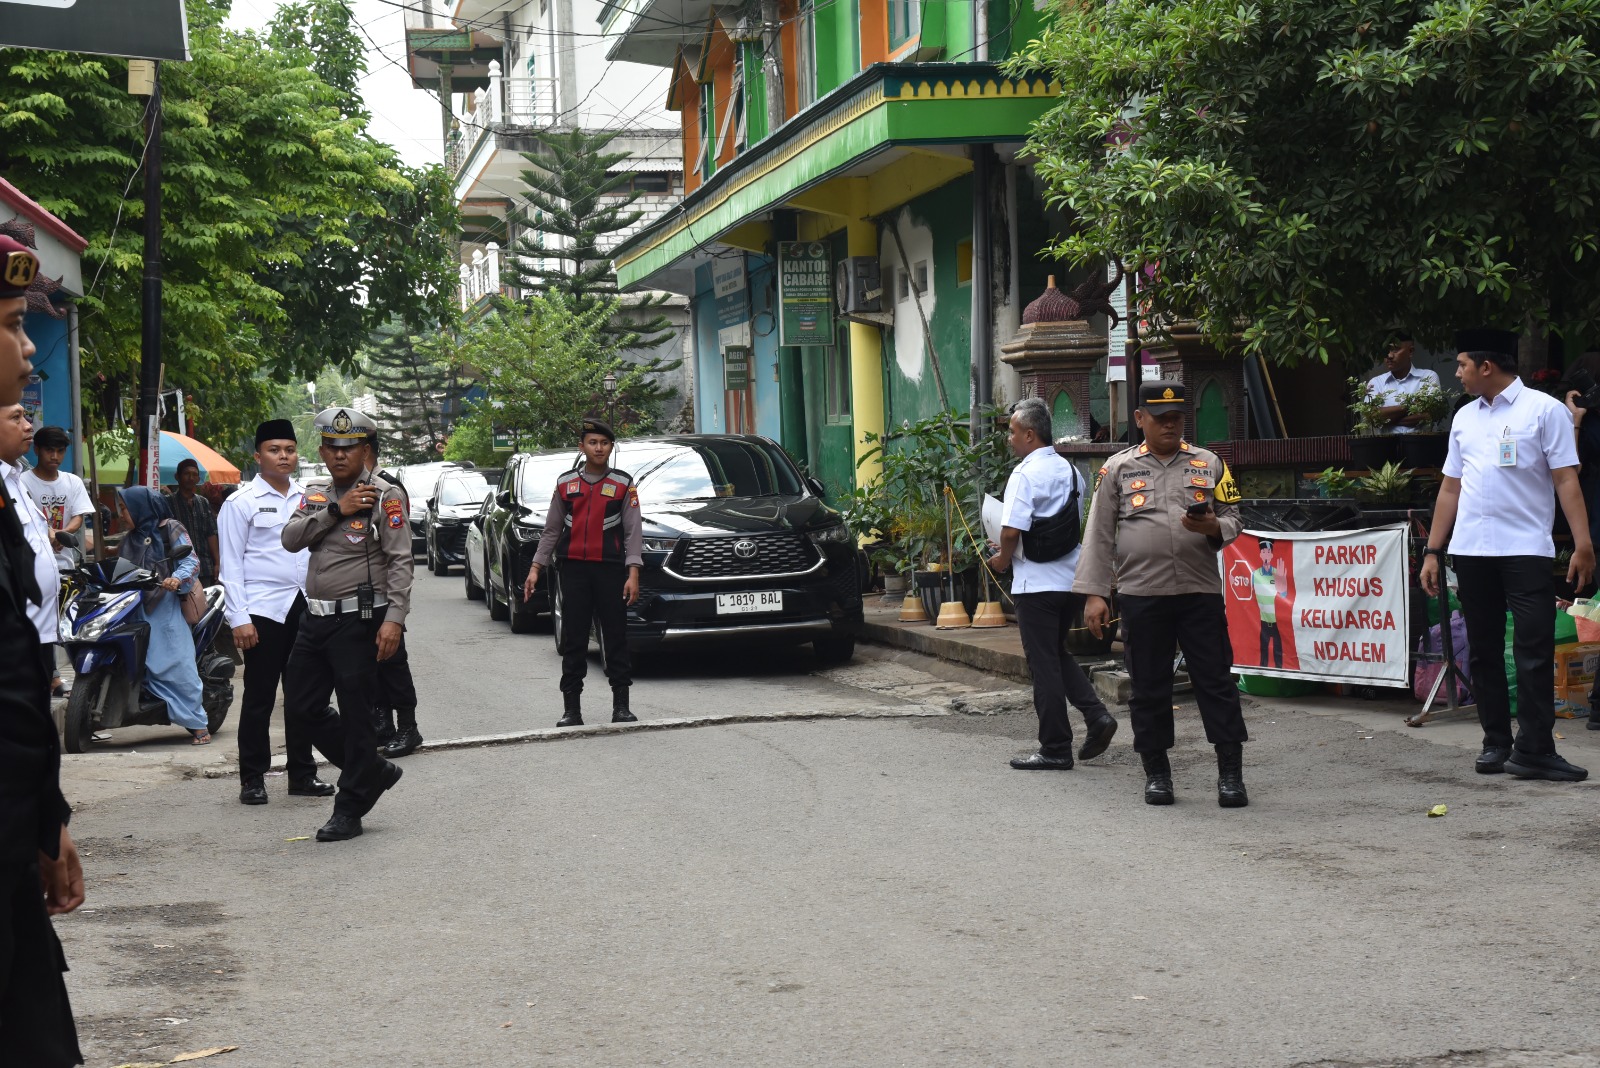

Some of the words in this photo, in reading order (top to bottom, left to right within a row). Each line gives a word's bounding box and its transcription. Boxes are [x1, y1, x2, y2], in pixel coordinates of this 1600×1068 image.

[784, 260, 830, 273] KANTOR
[784, 273, 830, 286] CABANG
[1184, 468, 1212, 476] POLRI
[1314, 544, 1377, 565] PARKIR
[1313, 577, 1384, 598] KHUSUS
[718, 595, 725, 607] L
[730, 593, 755, 607] 1819
[761, 592, 781, 605] BAL
[1301, 608, 1397, 630] KELUARGA
[1313, 641, 1387, 663] NDALEM
